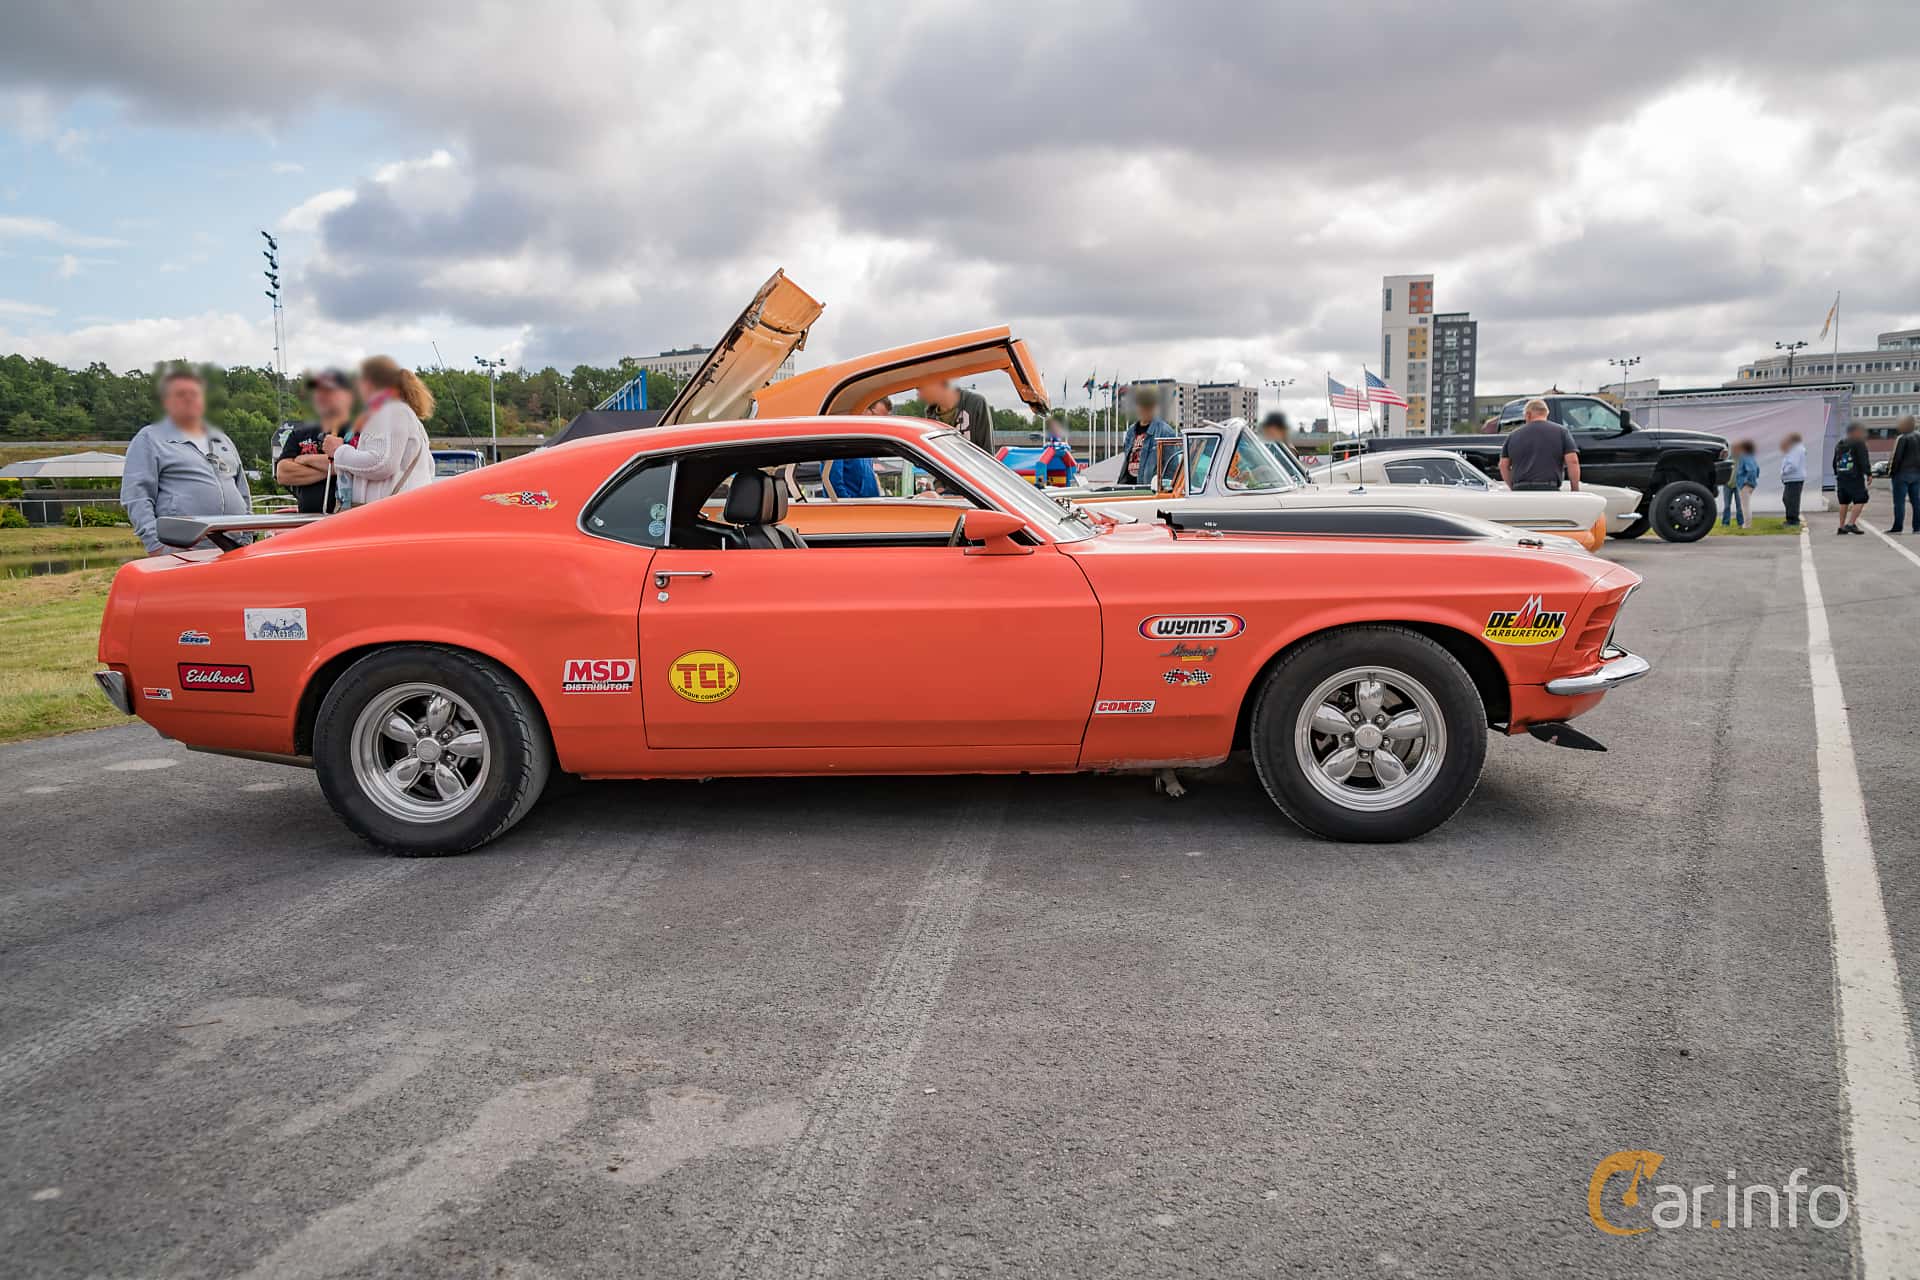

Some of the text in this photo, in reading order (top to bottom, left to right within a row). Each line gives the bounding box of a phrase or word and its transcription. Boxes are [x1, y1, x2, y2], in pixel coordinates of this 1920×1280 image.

[1488, 598, 1564, 628] DEMON
[1485, 629, 1558, 638] CARBURETION
[186, 669, 246, 685] Edelbrock
[568, 661, 630, 681] MSD
[676, 663, 726, 689] TCI
[565, 683, 630, 691] DISTRIBUTOR
[677, 684, 700, 699] TORQUE
[1098, 702, 1141, 711] COMP
